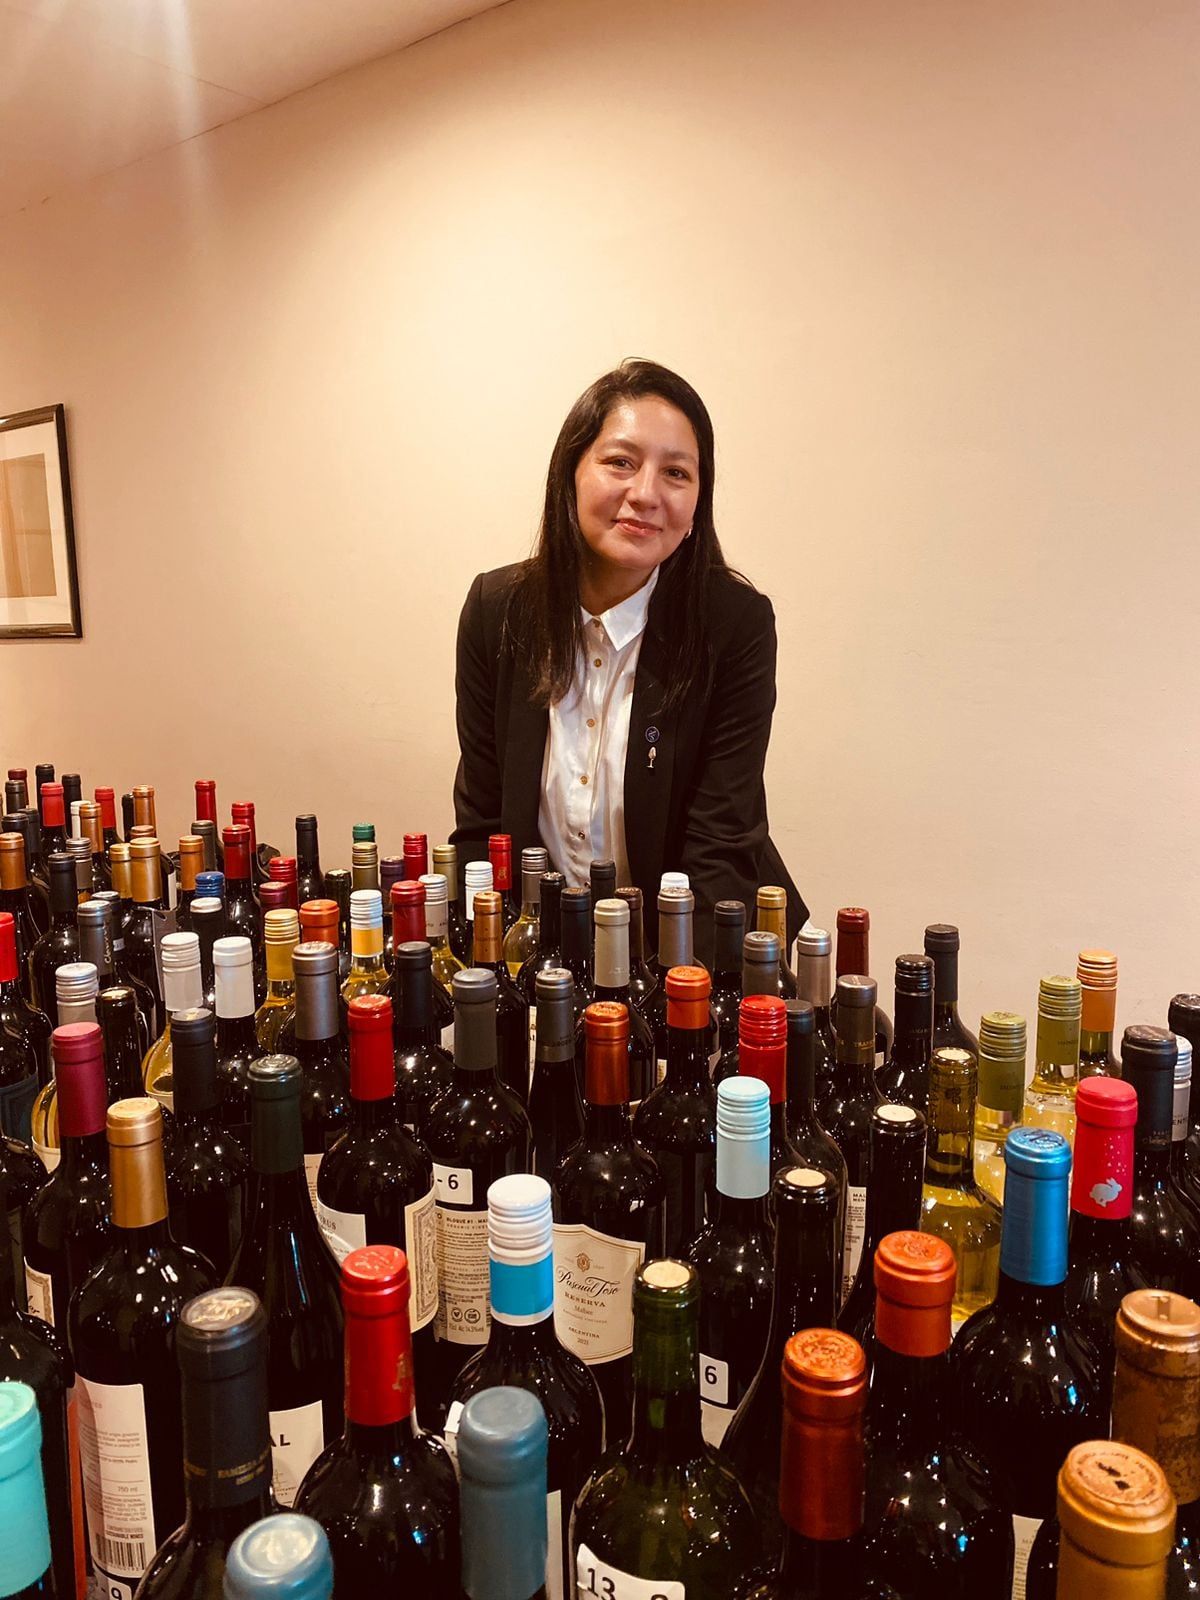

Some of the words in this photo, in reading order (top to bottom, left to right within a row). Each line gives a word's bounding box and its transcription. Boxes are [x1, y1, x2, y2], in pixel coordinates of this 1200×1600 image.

[447, 1173, 460, 1191] 6
[557, 1265, 598, 1294] Pascual
[564, 1291, 606, 1308] RESERVA
[704, 1364, 718, 1385] 6
